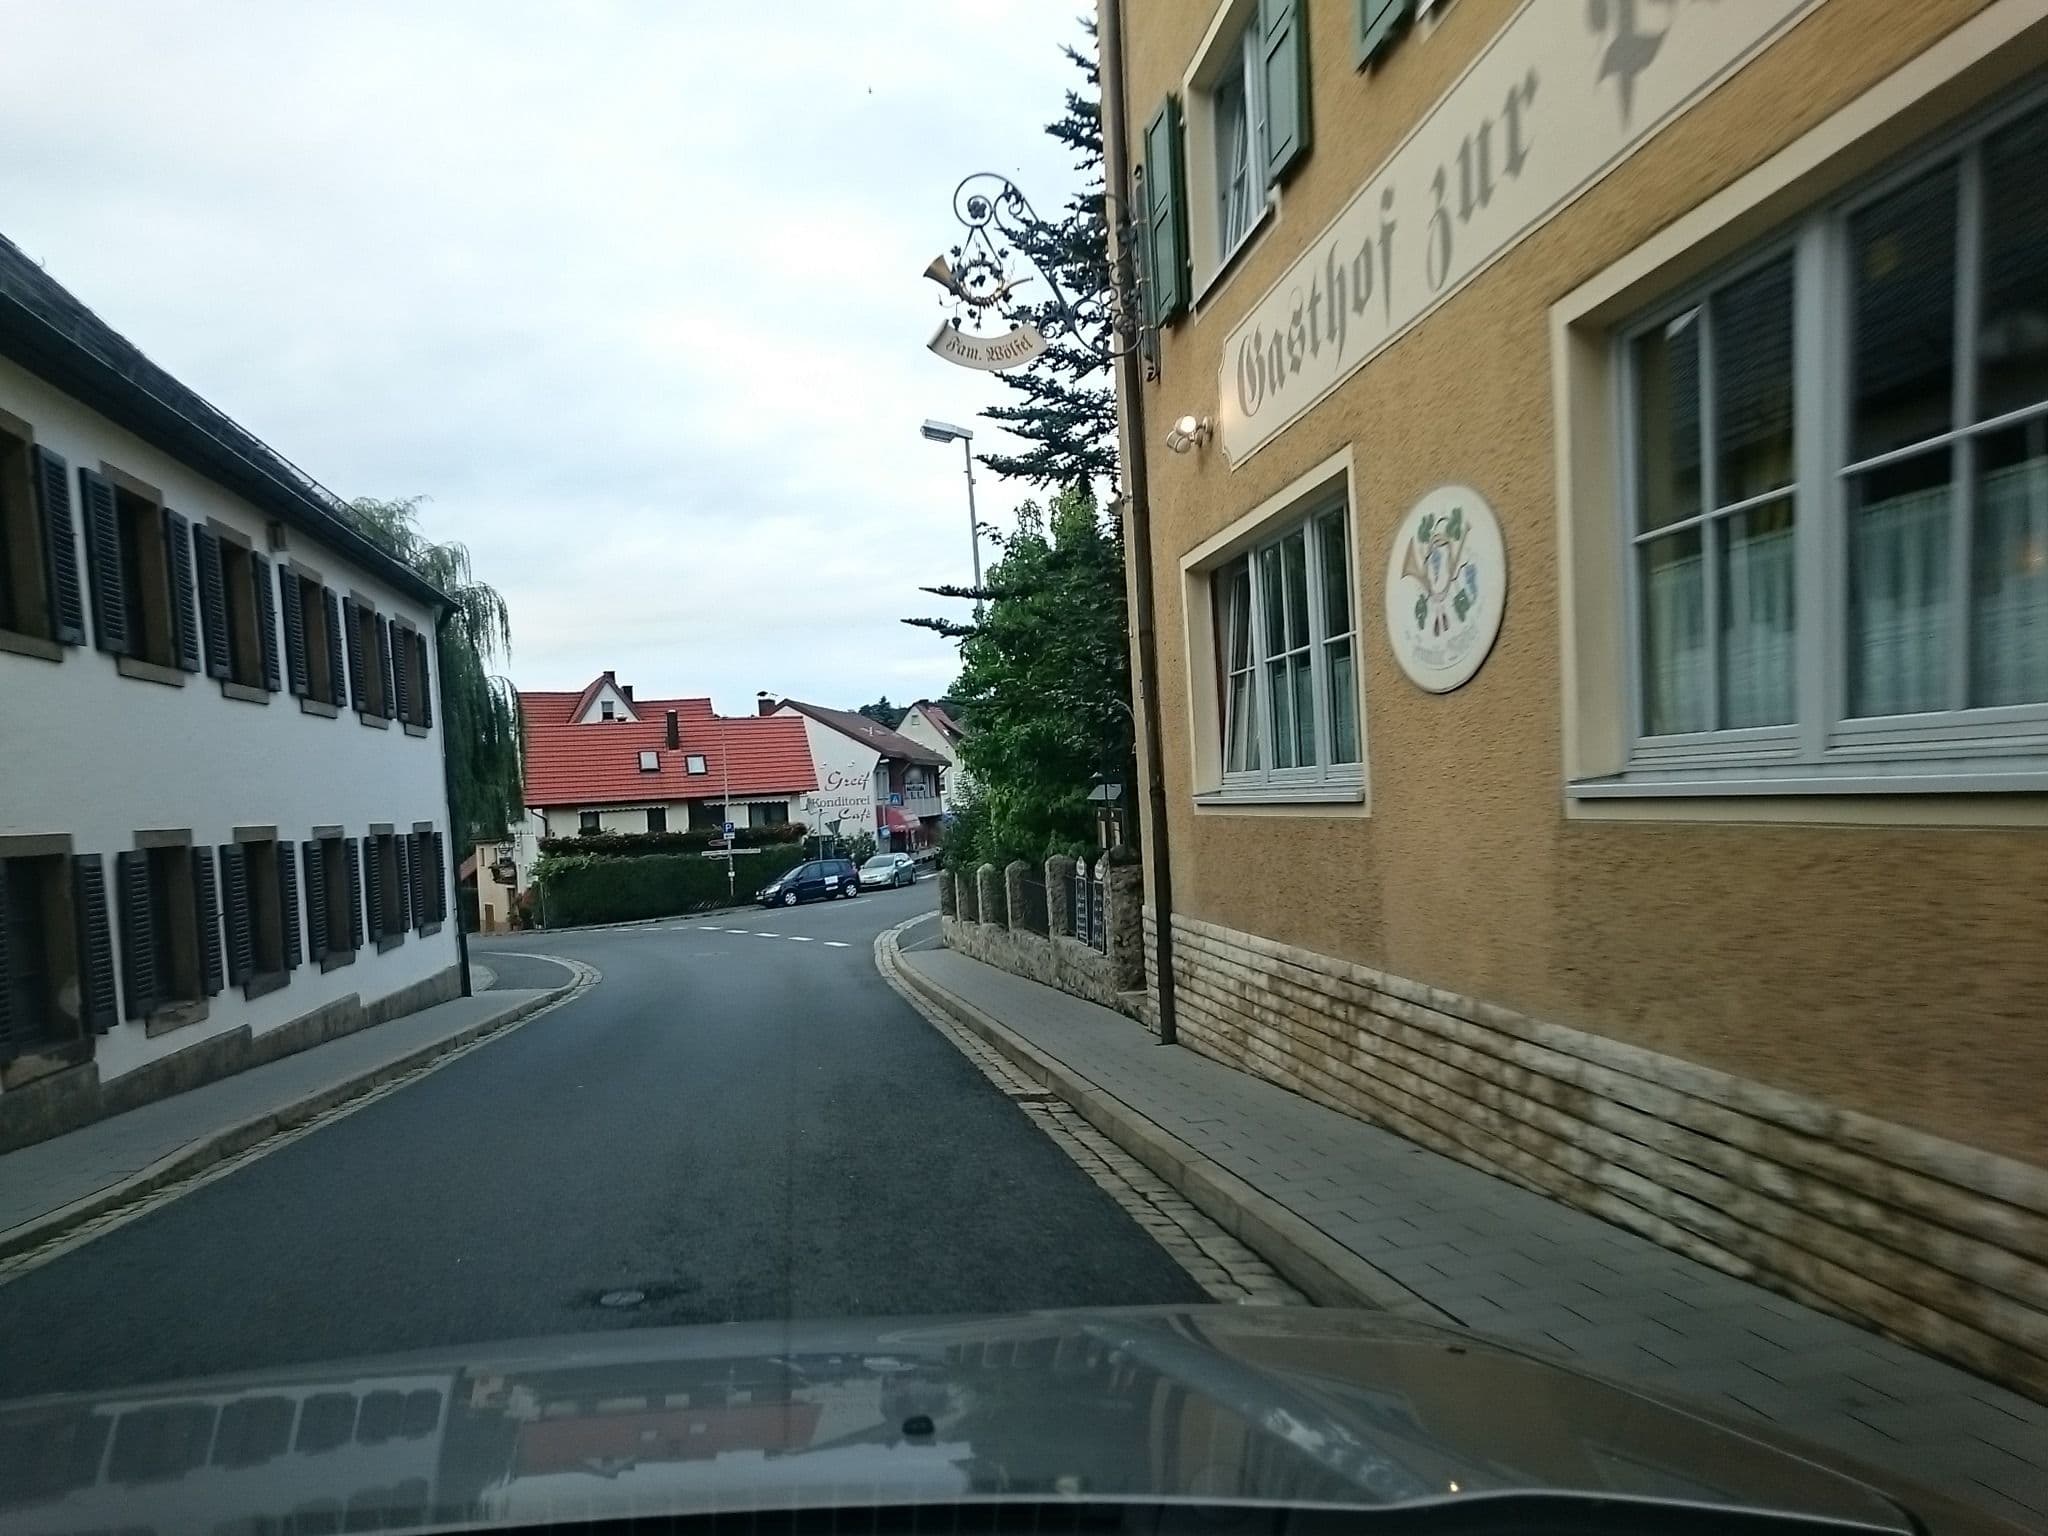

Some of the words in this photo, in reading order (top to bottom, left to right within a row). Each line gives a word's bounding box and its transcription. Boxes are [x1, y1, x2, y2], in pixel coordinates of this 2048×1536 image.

[1236, 186, 1398, 418] Gasthof
[1426, 65, 1541, 293] zur
[945, 337, 982, 361] Fam.
[824, 770, 870, 791] Greif
